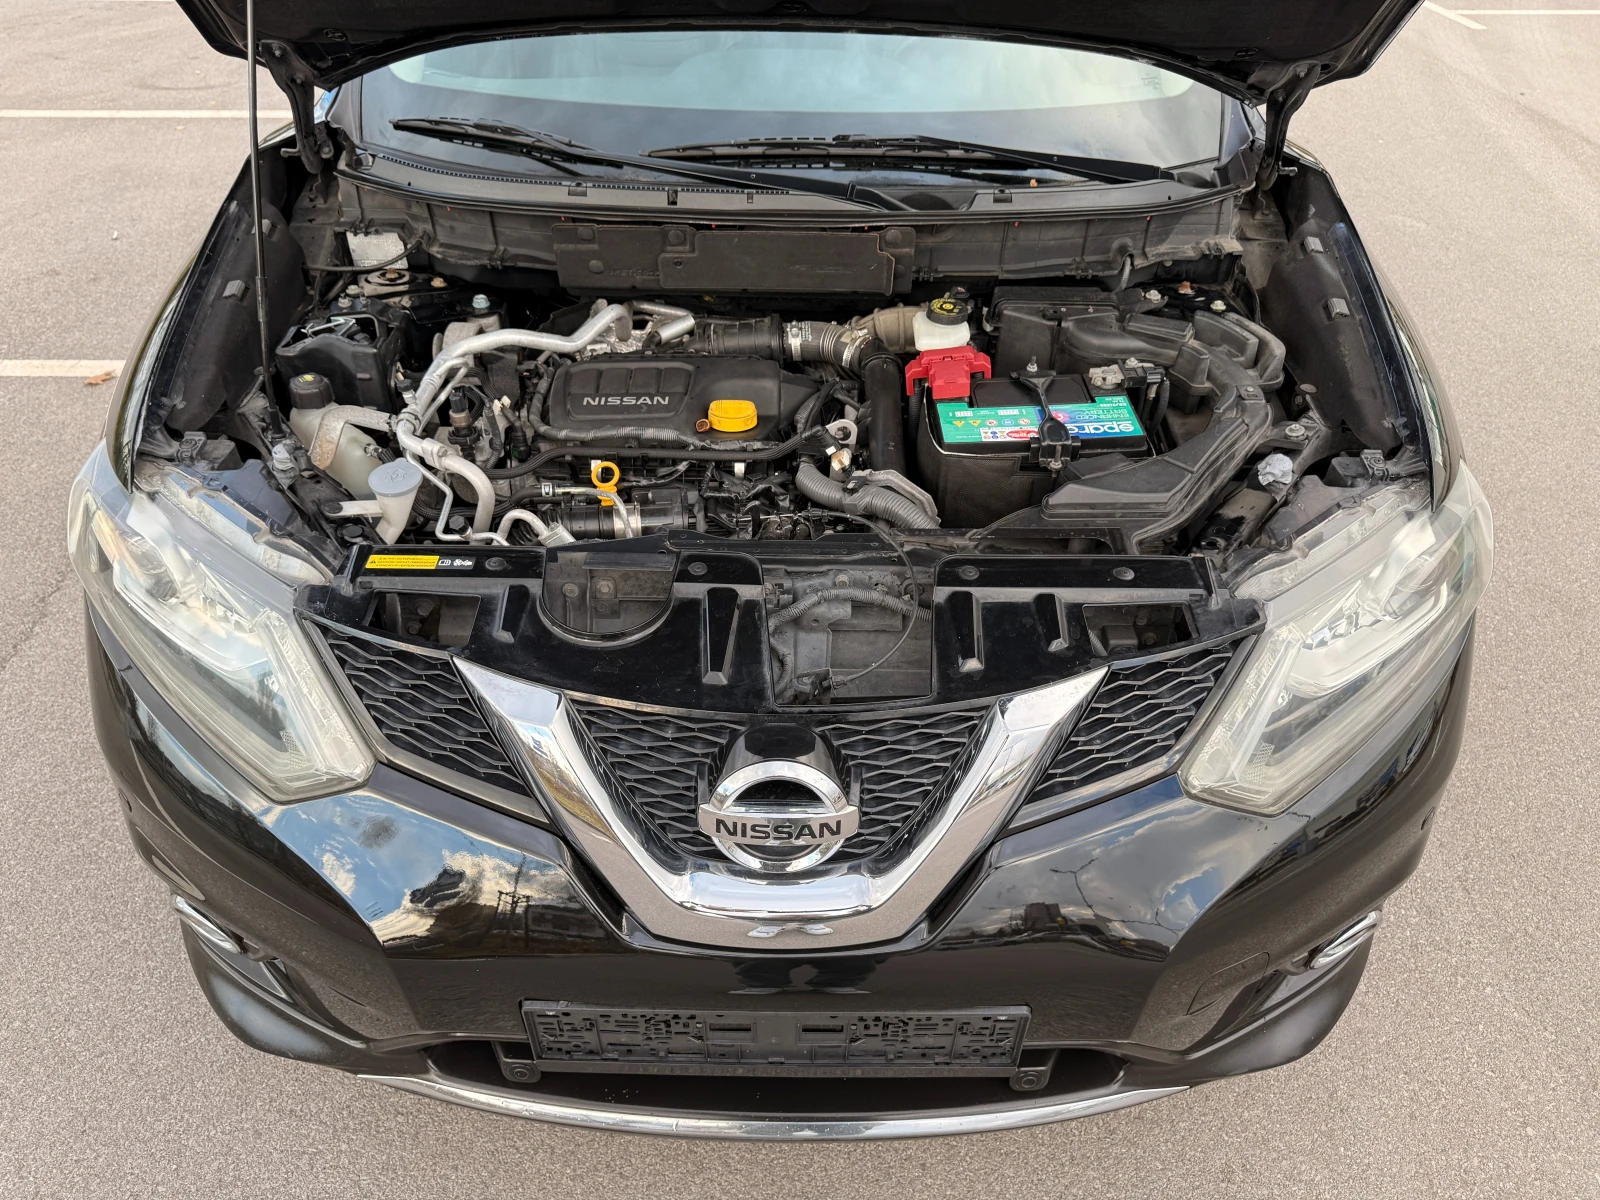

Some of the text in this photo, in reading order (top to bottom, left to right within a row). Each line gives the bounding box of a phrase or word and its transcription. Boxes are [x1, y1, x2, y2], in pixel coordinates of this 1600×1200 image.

[583, 396, 669, 406] NISSAN
[1066, 421, 1134, 433] sparc
[715, 818, 842, 841] NISSAN
